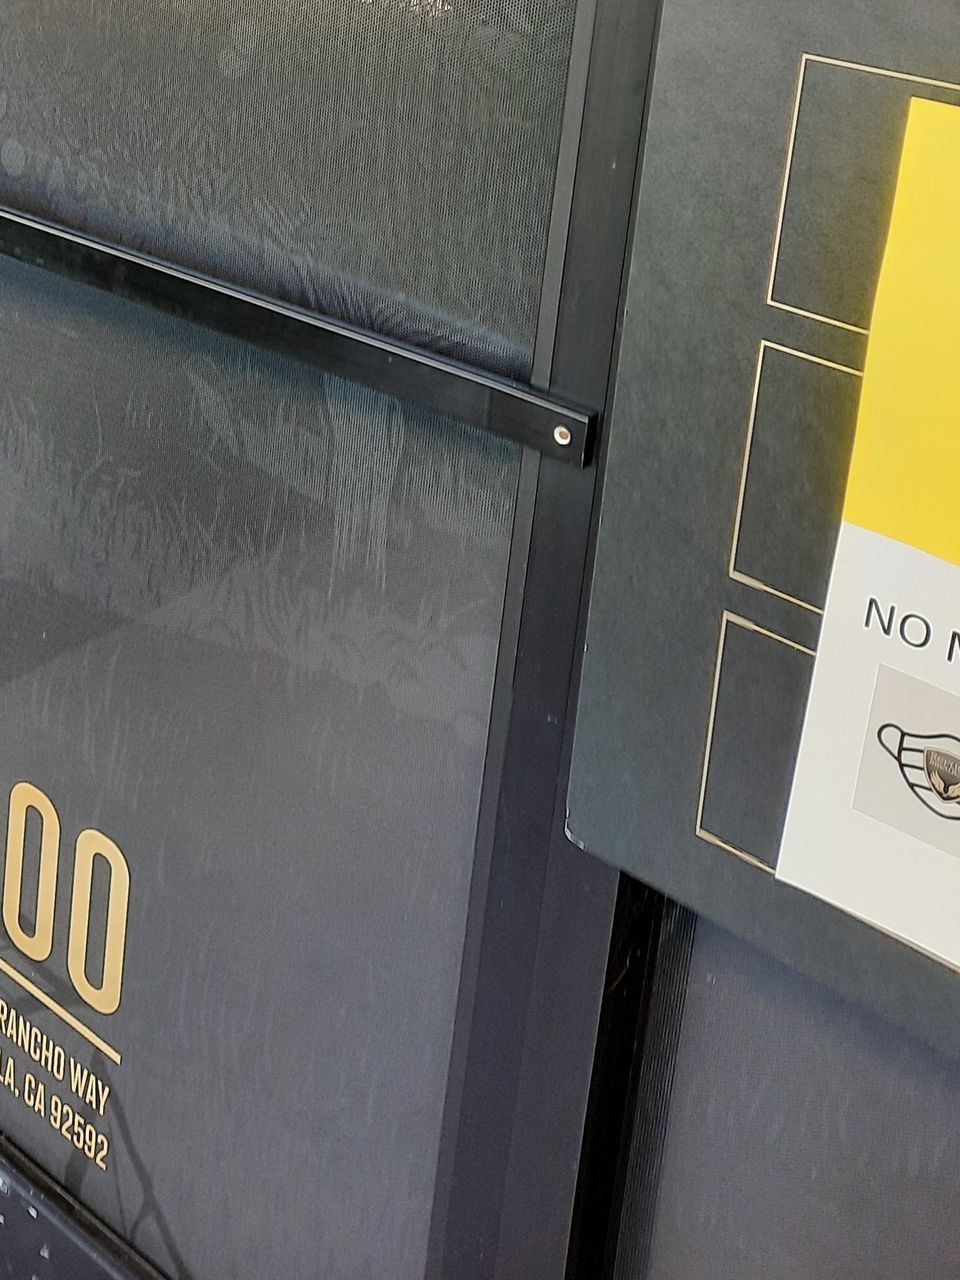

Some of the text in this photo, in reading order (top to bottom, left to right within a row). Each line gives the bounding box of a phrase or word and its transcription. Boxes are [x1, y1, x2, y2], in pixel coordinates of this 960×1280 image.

[864, 596, 932, 649] NO
[69, 1056, 111, 1117] WAY
[23, 1072, 45, 1118] CA
[49, 1095, 109, 1171] 92592
